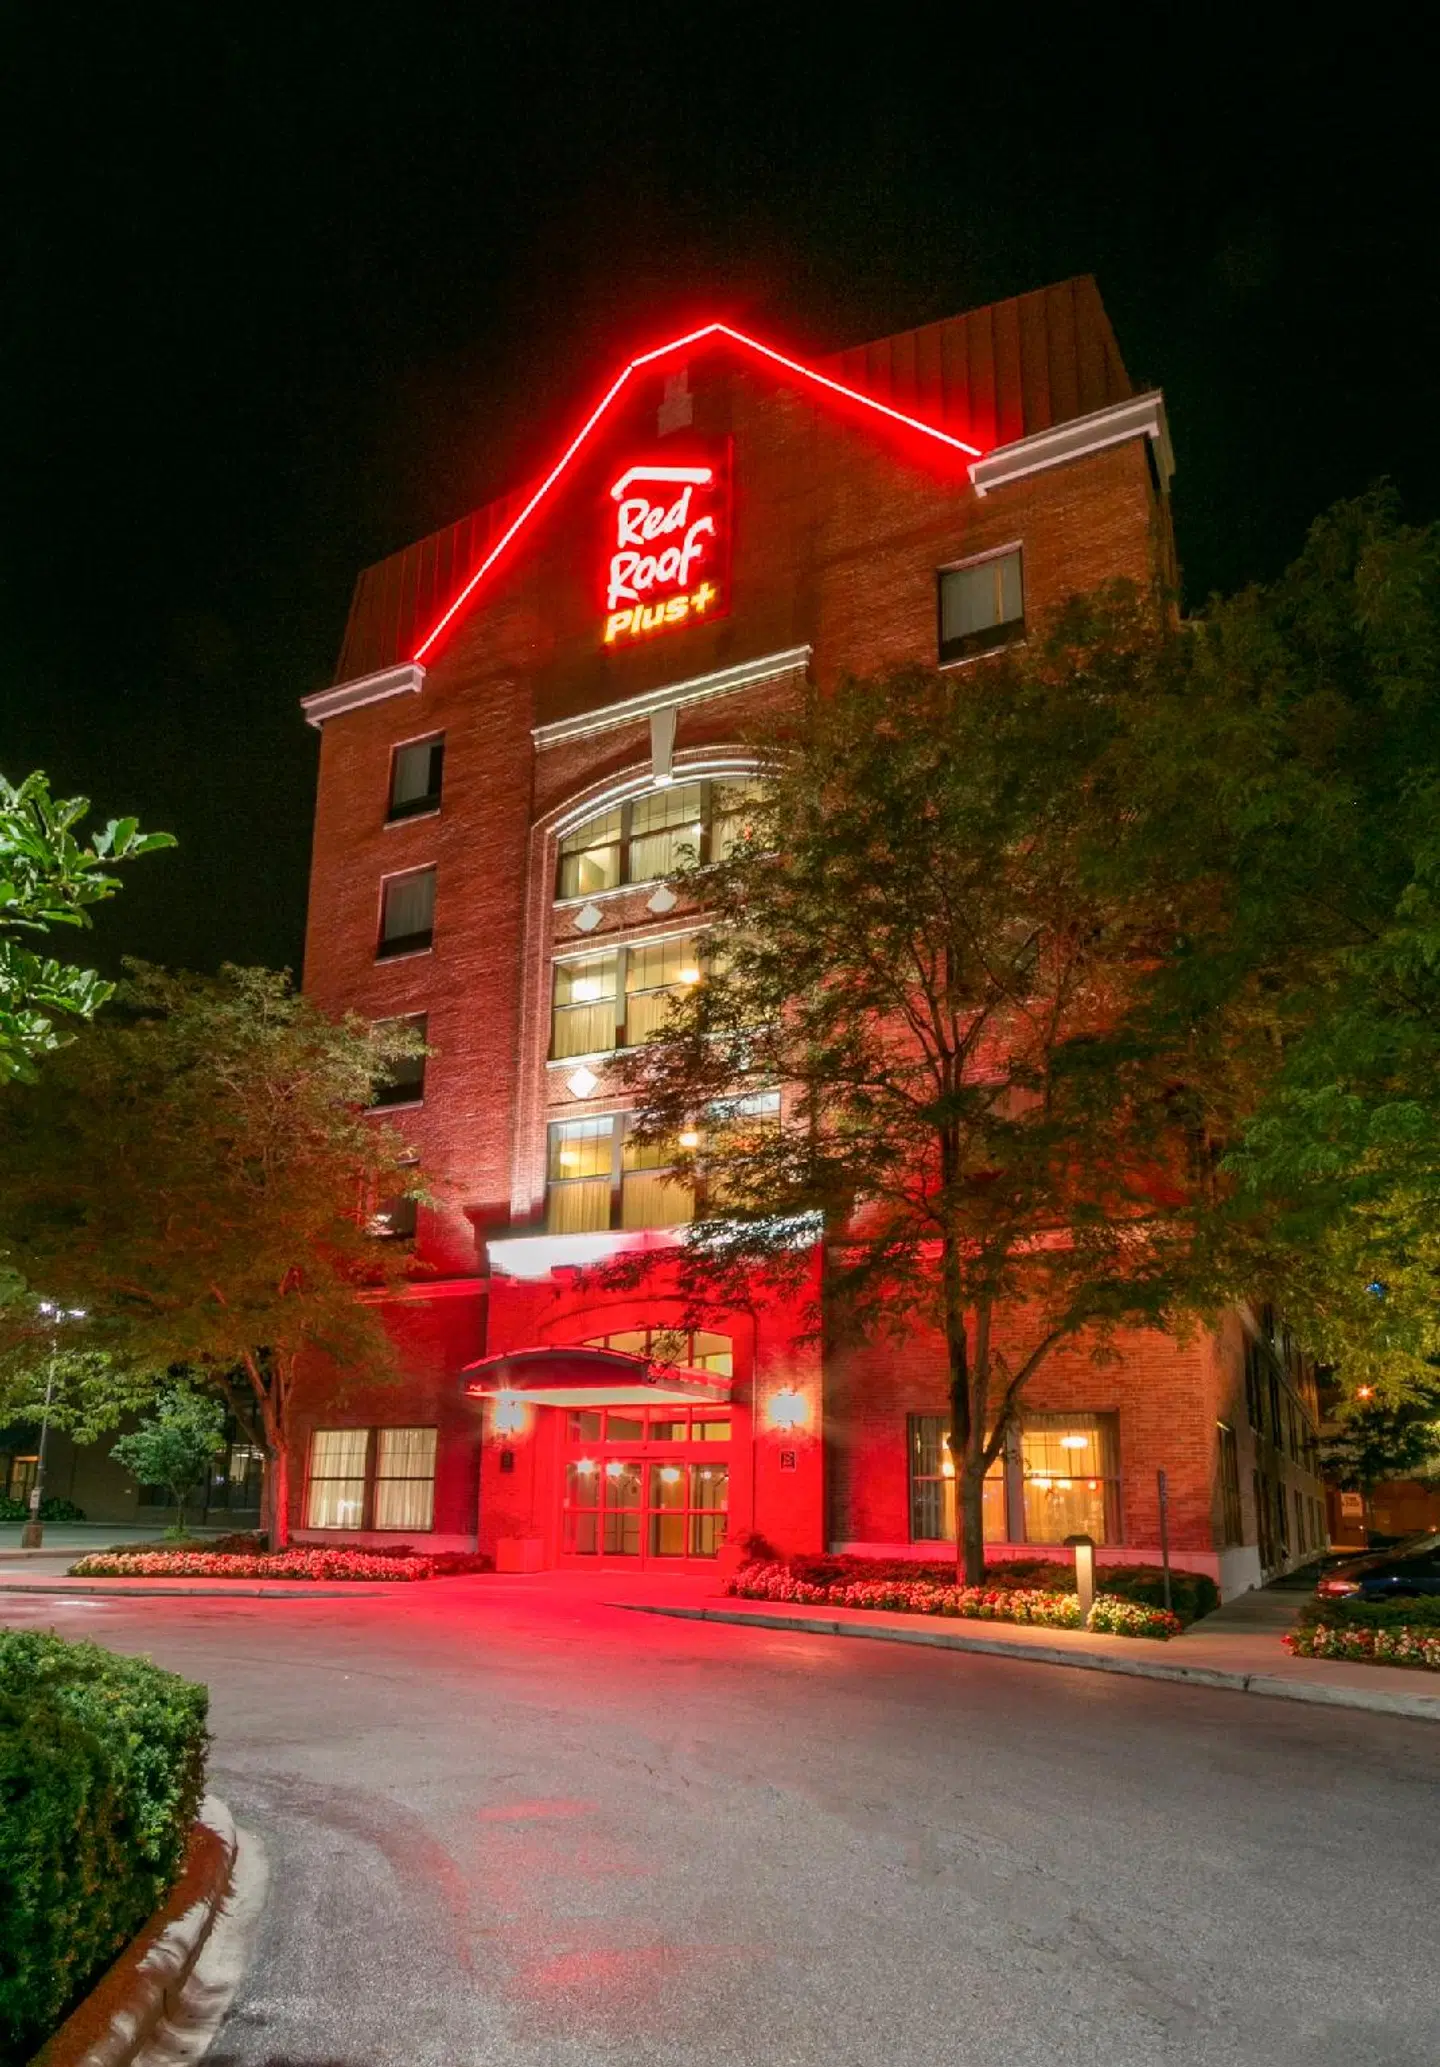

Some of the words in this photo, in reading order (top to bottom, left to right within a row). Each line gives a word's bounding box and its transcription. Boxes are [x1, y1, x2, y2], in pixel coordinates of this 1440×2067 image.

[617, 486, 693, 548] Red
[606, 516, 714, 610] Roof
[603, 581, 717, 643] Plus+
